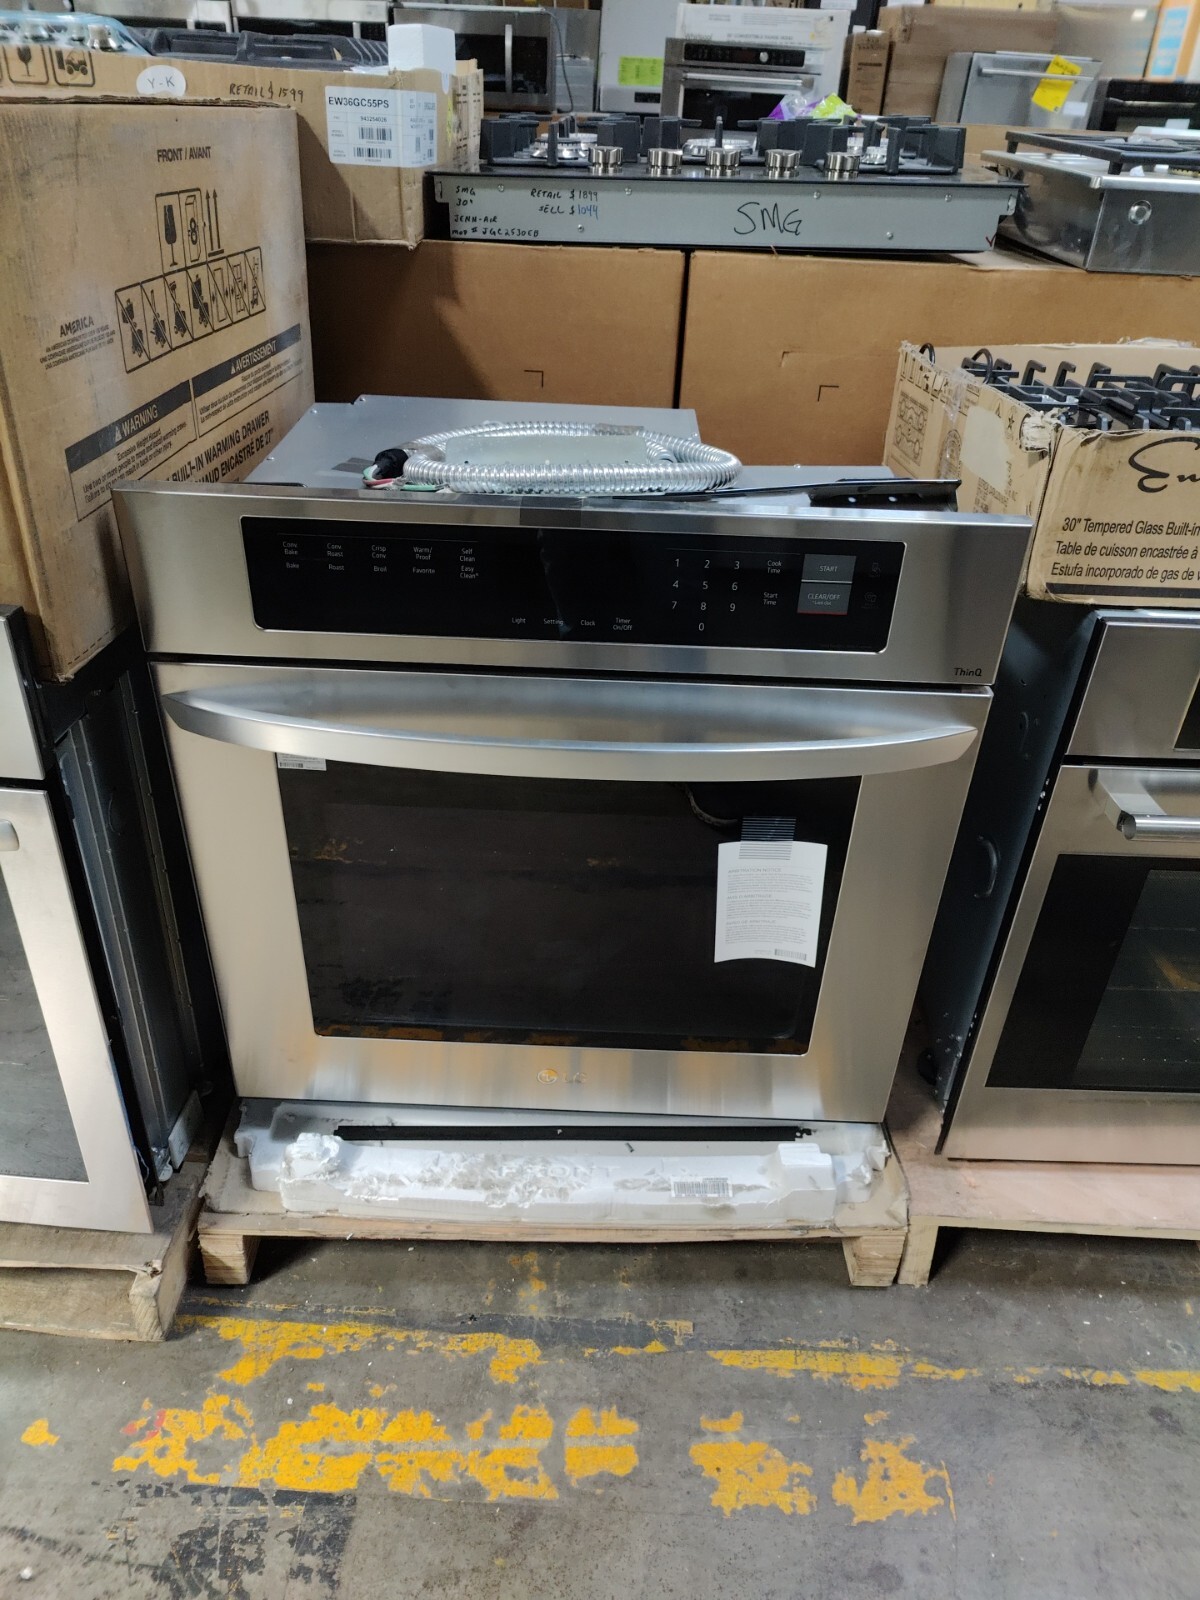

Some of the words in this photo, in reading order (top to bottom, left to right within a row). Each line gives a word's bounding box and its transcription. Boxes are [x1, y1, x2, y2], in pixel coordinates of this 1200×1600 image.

[229, 83, 265, 98] RETAIL
[328, 96, 390, 109] EW36GC55PS
[157, 148, 182, 162] FRONT
[189, 146, 212, 160] AVANT
[530, 189, 563, 199] RETAIL
[733, 201, 803, 236] SMG
[60, 315, 94, 338] AMERICA
[235, 340, 277, 372] AVERTISSEMENT
[121, 404, 158, 437] WARNING
[172, 454, 205, 482] BUILT-IN
[204, 430, 241, 465] WARMING
[241, 410, 270, 441] DRAWER
[221, 441, 255, 477] ENCASTRÉ
[255, 437, 264, 453] DE
[1062, 517, 1082, 532] 30"
[1083, 518, 1134, 536] Tempered
[1135, 520, 1163, 536] Glass
[1056, 540, 1082, 556] Table
[1084, 543, 1097, 556] de
[1099, 543, 1138, 558] cuisson
[1139, 545, 1188, 560] encastrée
[1190, 549, 1198, 560] à
[675, 559, 680, 567] 1
[704, 560, 710, 569] 2
[734, 561, 740, 570] 3
[461, 565, 475, 573] Easy
[1051, 562, 1084, 577] Estufa
[1085, 564, 1144, 581] incorporado
[1145, 566, 1159, 580] de
[1160, 569, 1179, 583] gas
[1181, 567, 1195, 581] de
[672, 580, 679, 588] 4
[702, 581, 709, 590] 5
[731, 582, 738, 591] 6
[671, 601, 678, 610] 7
[700, 602, 707, 611] 8
[730, 603, 736, 612] 9
[512, 617, 526, 625] Light
[698, 623, 705, 631] 0
[953, 667, 983, 677] ThinQ
